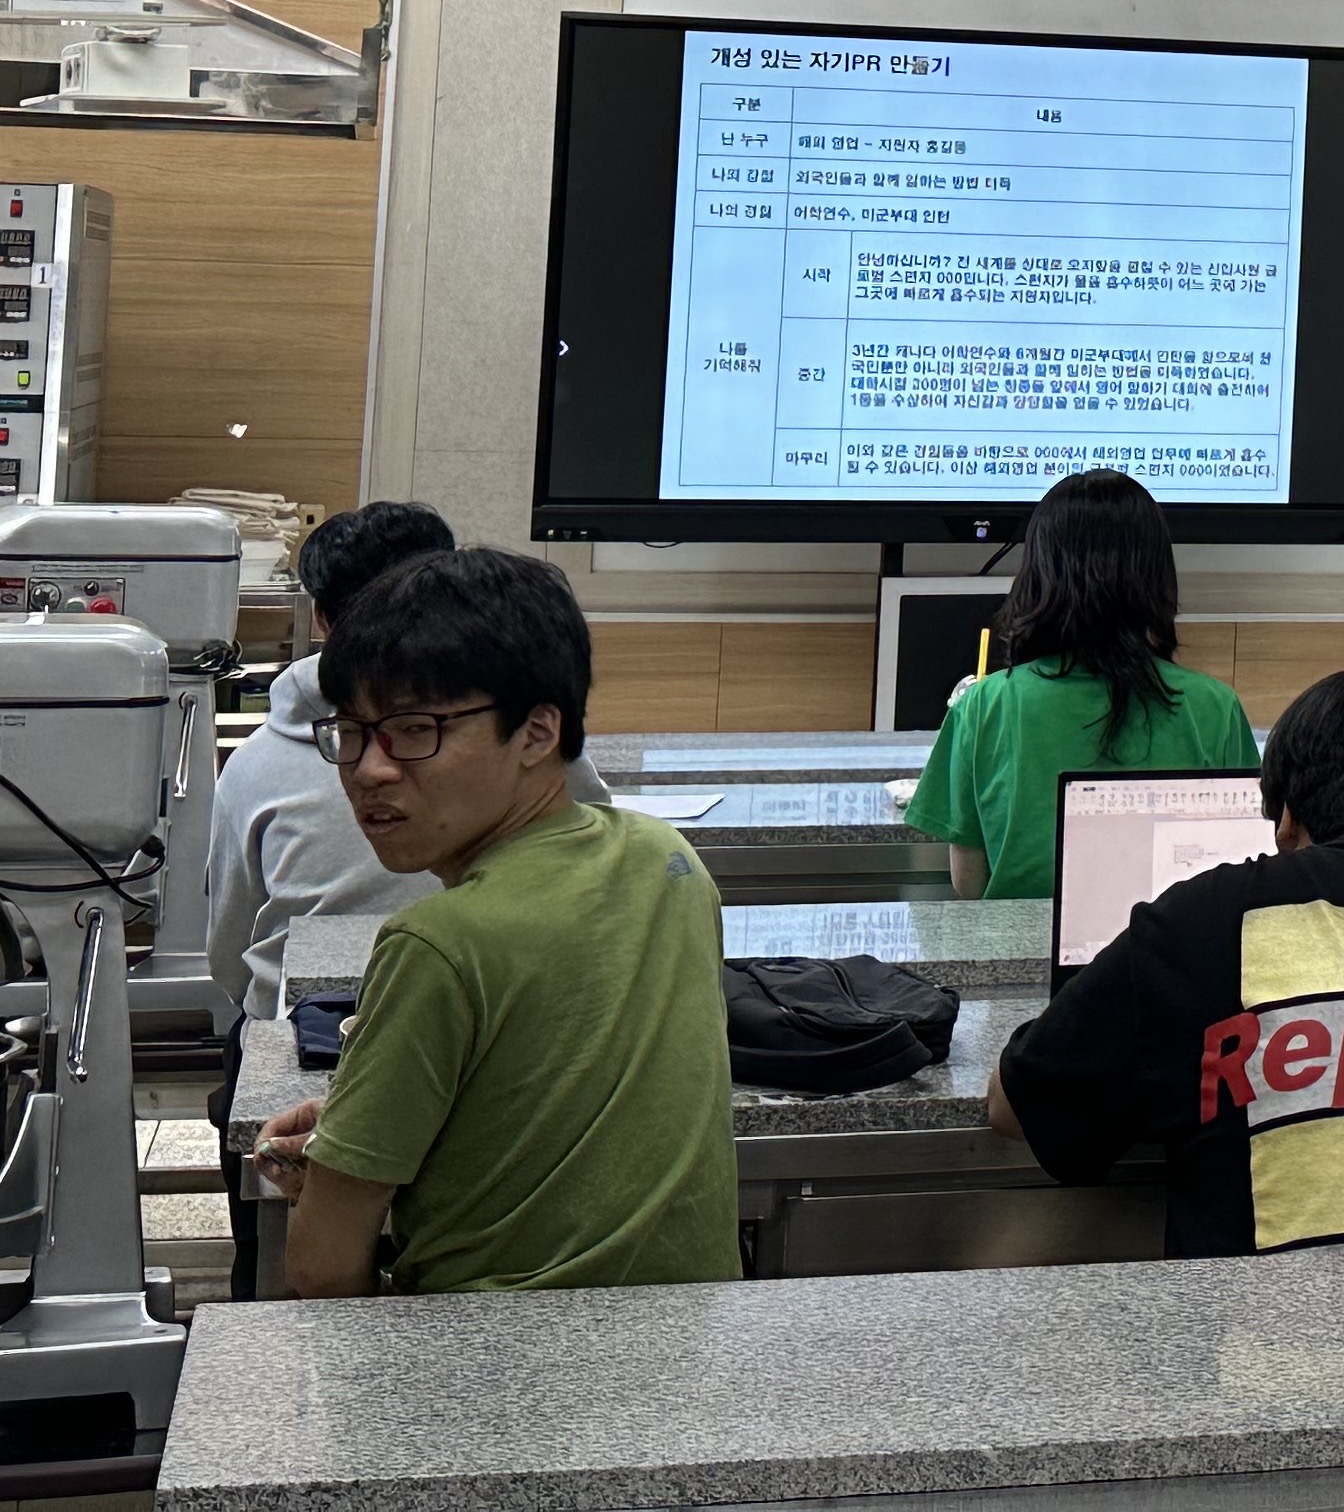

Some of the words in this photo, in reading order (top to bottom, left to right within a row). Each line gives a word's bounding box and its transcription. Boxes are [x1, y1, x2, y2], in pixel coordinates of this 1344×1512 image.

[710, 47, 752, 69] 개성
[761, 49, 801, 70] 있는
[809, 51, 881, 74] 자기PR
[890, 54, 950, 77] 만들기
[739, 132, 769, 148] 누구
[38, 266, 47, 284] 1
[803, 268, 831, 283] 시작
[785, 451, 828, 466] 마무리
